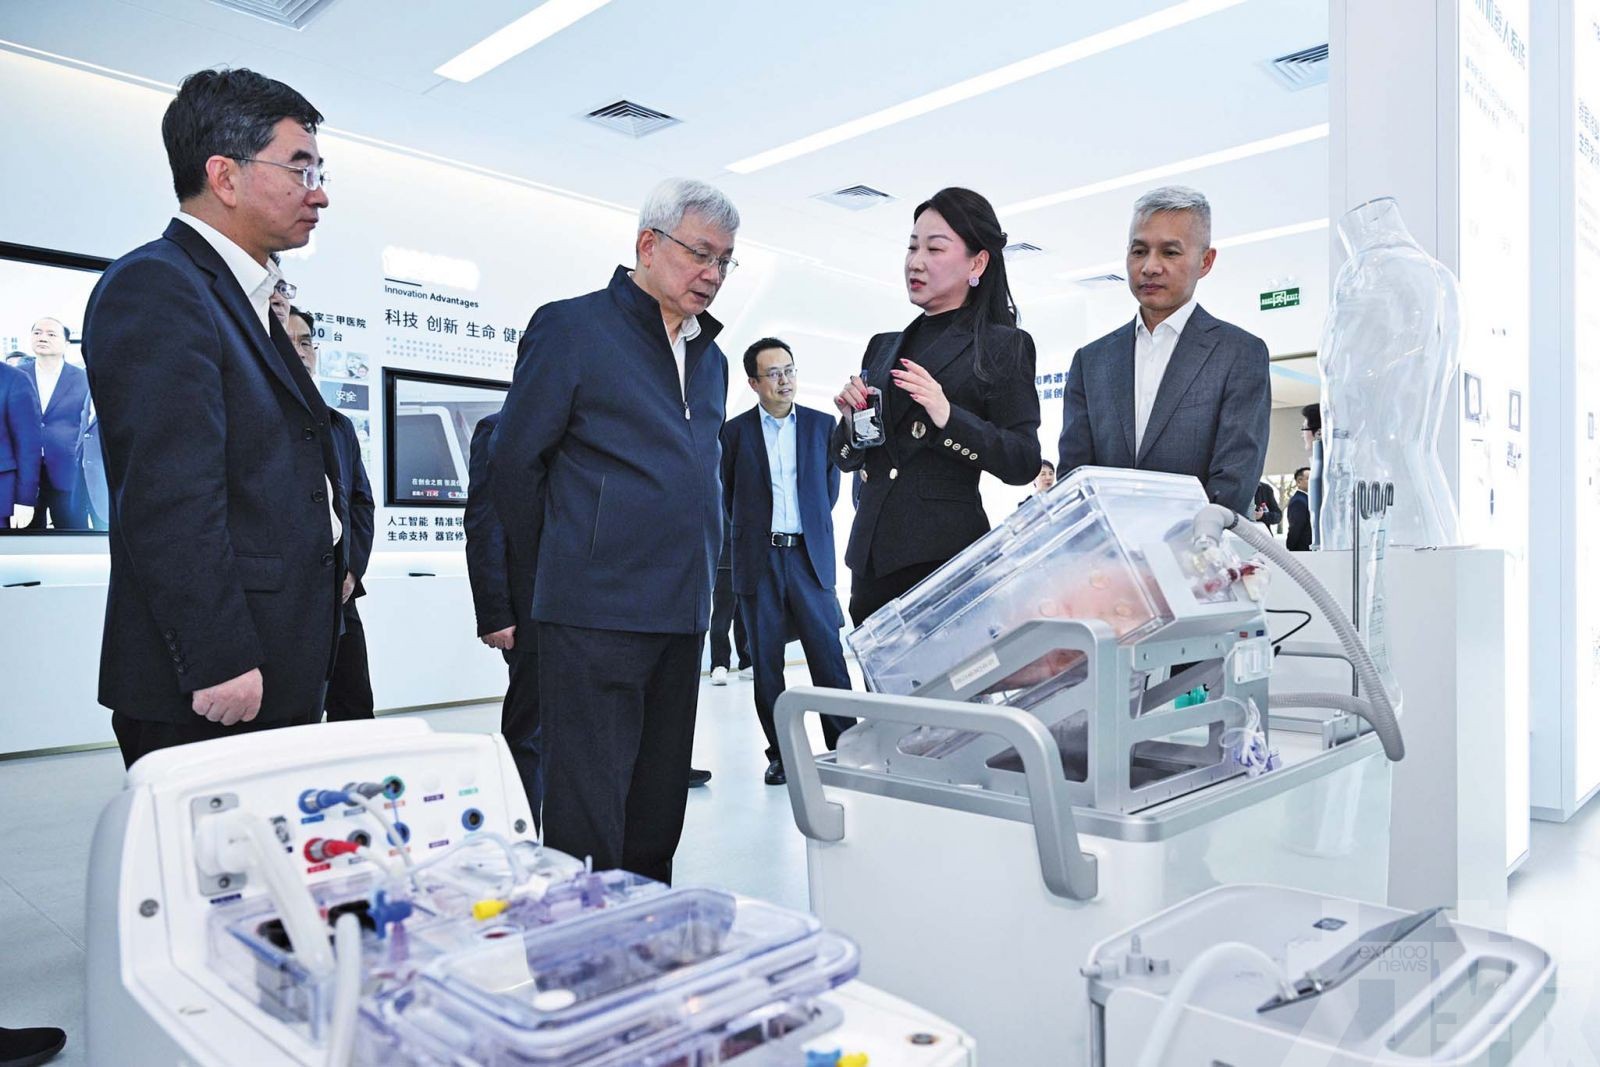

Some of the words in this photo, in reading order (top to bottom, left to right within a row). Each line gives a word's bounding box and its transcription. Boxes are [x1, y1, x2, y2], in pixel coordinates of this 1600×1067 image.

[384, 285, 428, 299] Innovation
[430, 293, 479, 308] Advantages
[385, 308, 418, 329] 科技
[427, 315, 458, 335] 创新
[466, 321, 496, 340] 生命
[336, 390, 357, 403] 安全
[388, 516, 428, 527] 人工智能
[435, 516, 463, 527] 精准导
[388, 531, 428, 541] 生命支持
[435, 531, 464, 541] 器官修
